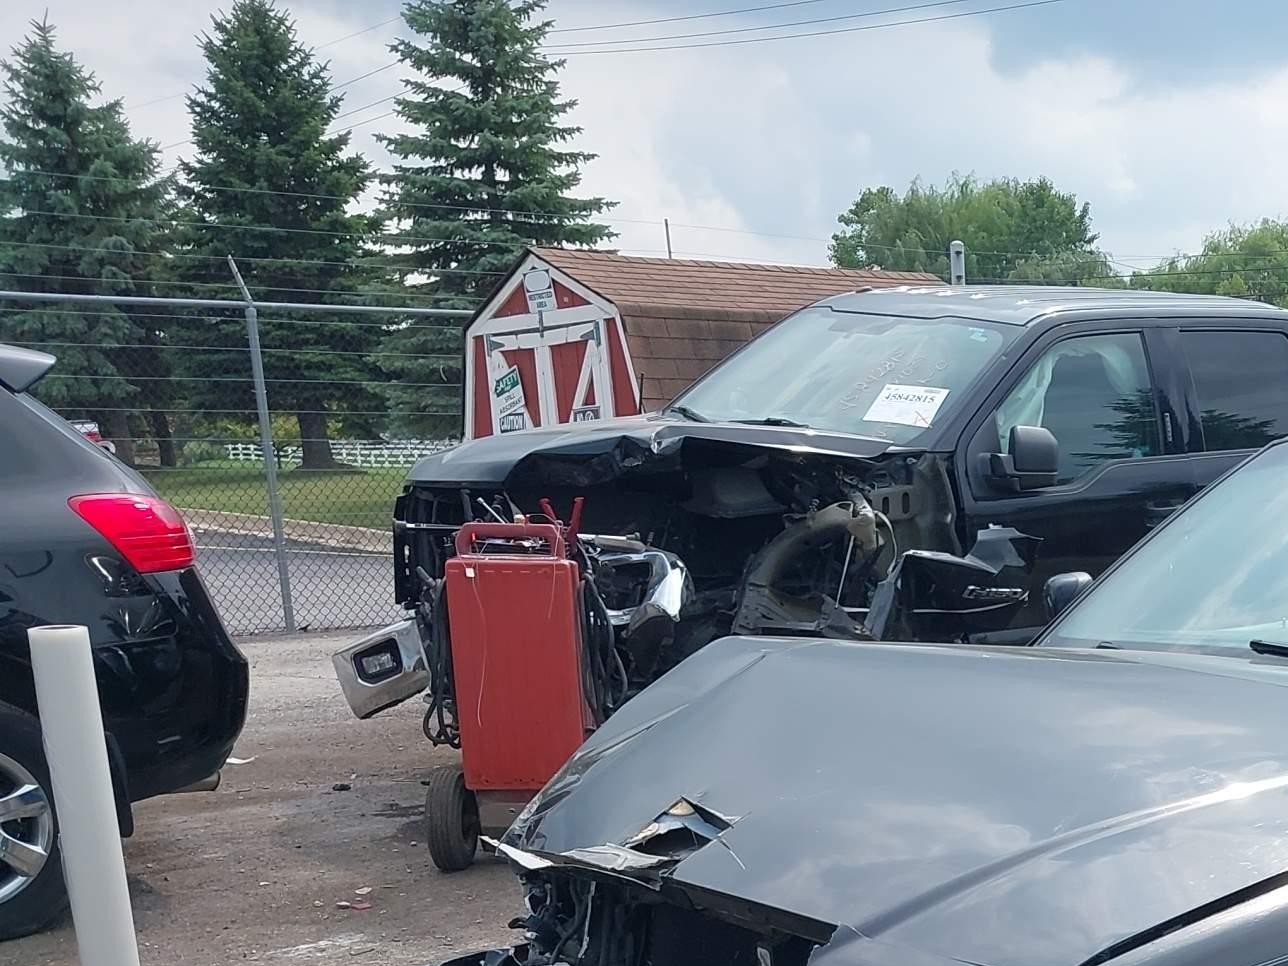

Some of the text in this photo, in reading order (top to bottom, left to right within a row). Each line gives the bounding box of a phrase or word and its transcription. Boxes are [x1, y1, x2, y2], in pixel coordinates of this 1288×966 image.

[494, 371, 518, 394] SAFETY
[884, 391, 936, 404] 45842815
[500, 414, 523, 431] CAUTION
